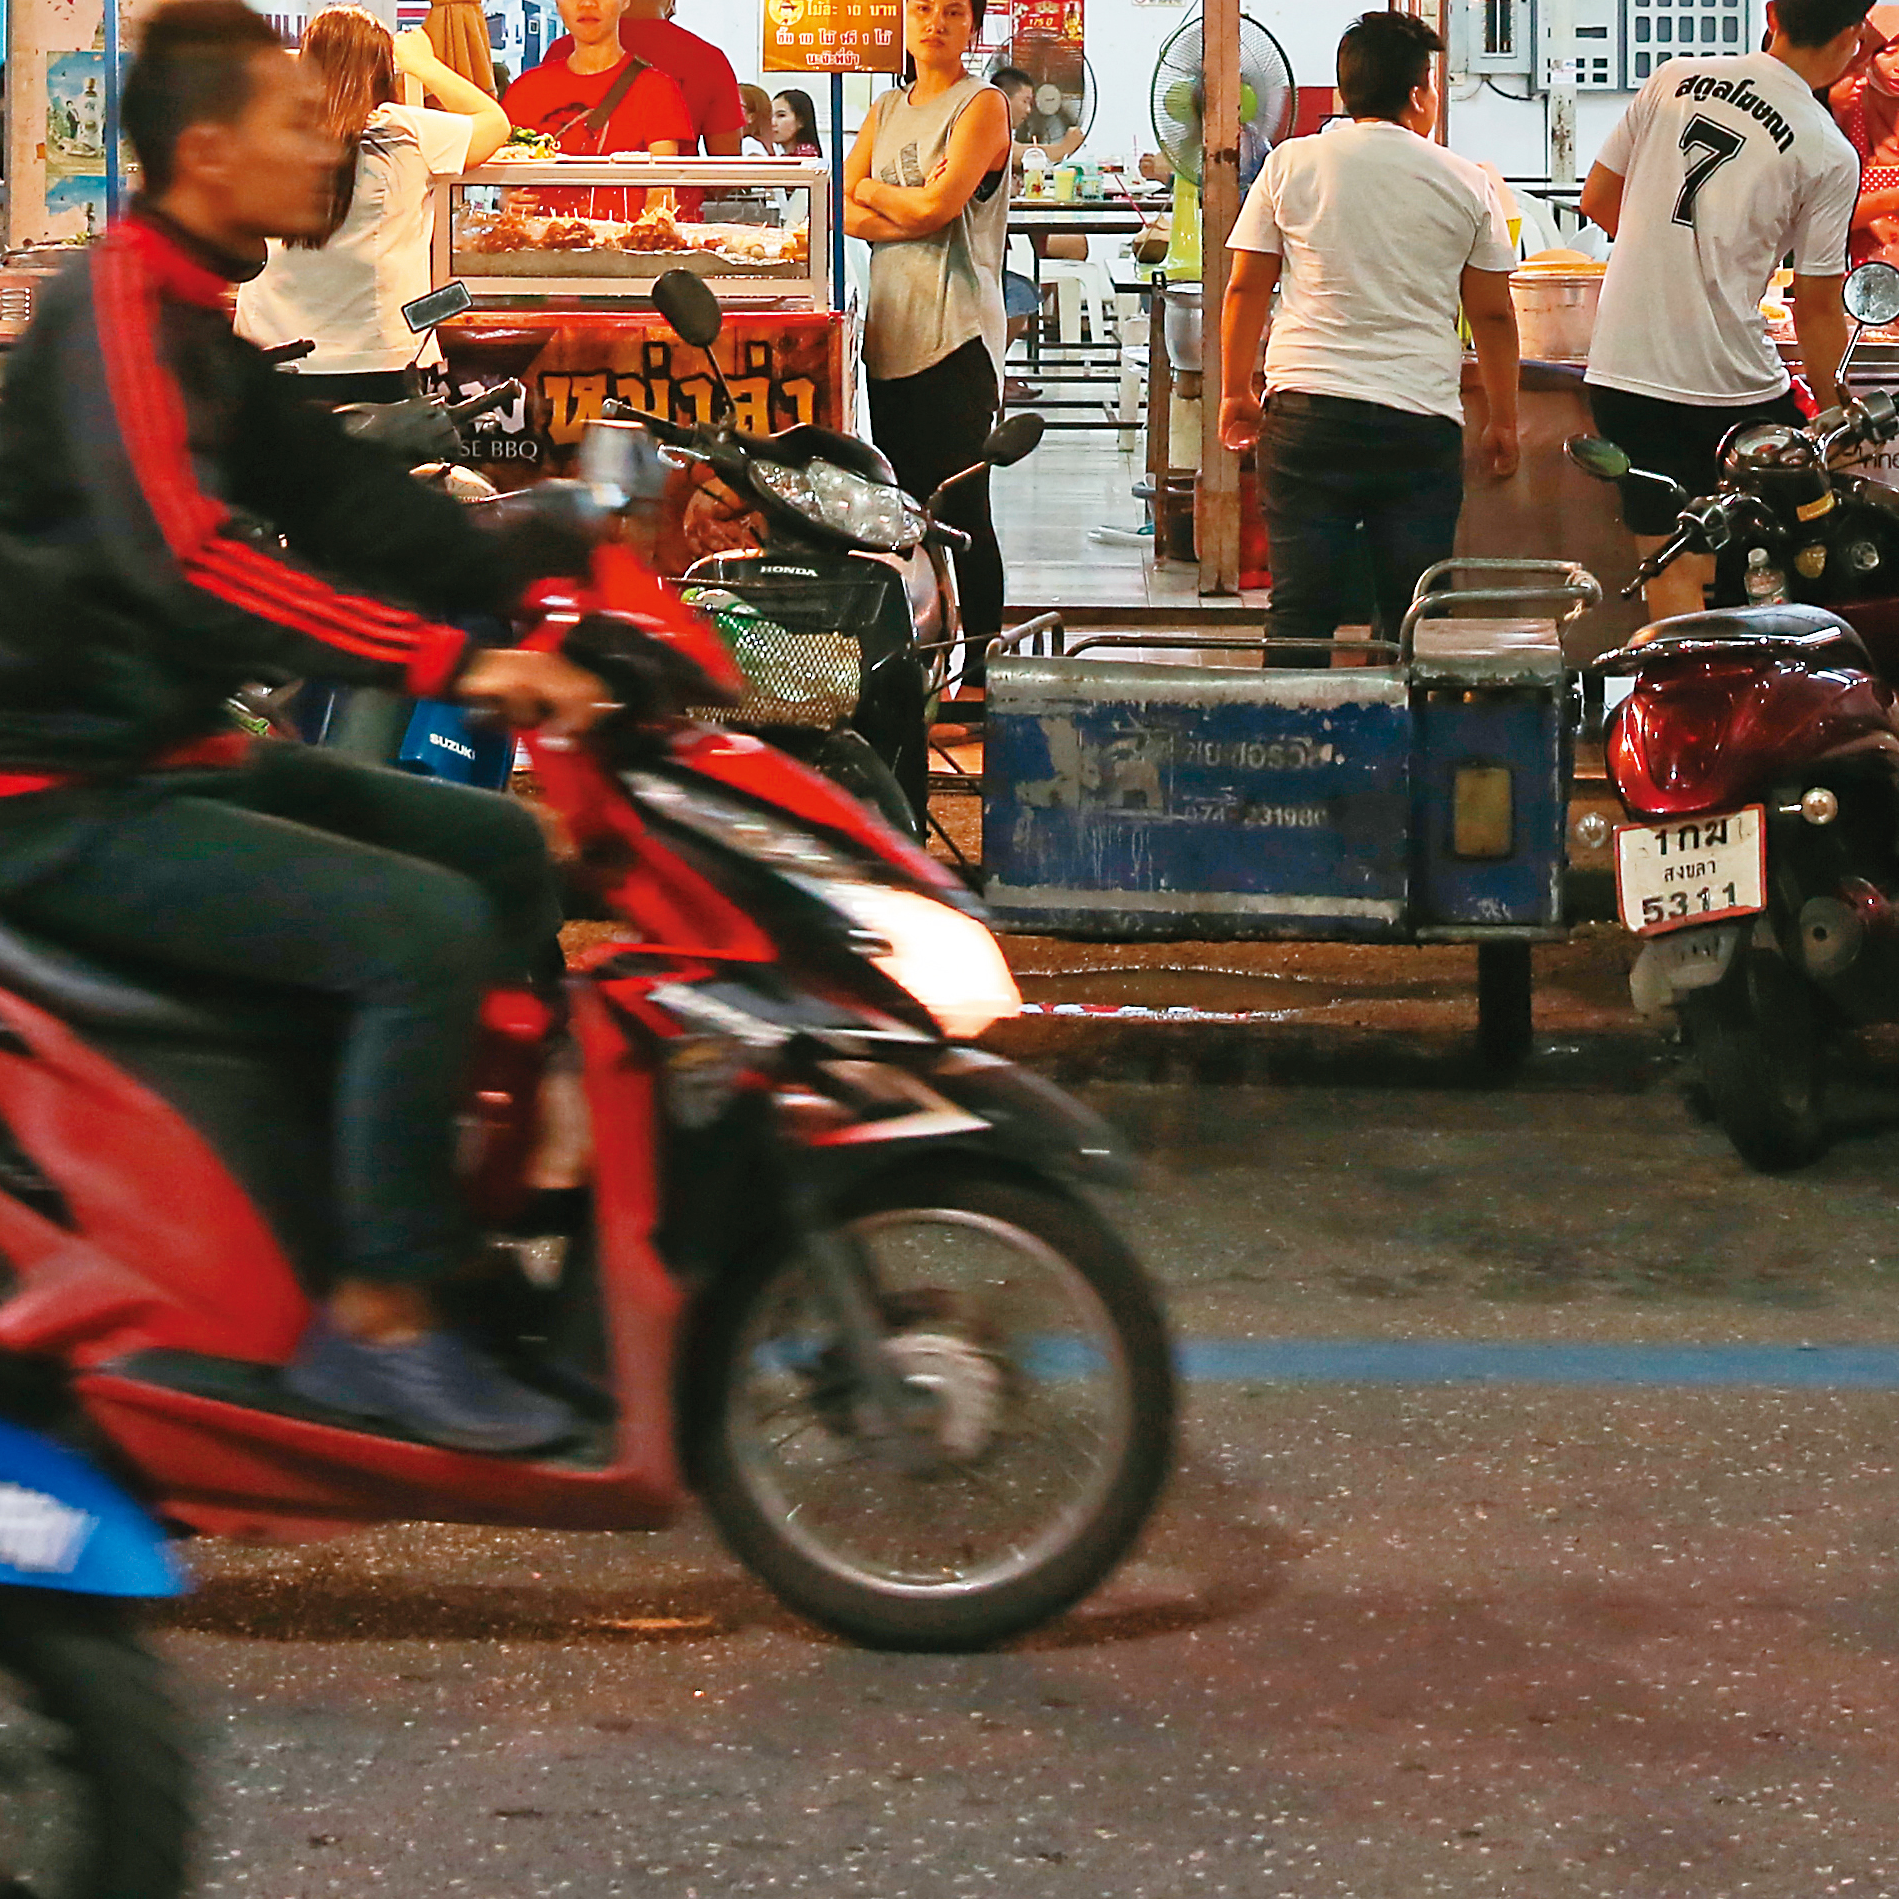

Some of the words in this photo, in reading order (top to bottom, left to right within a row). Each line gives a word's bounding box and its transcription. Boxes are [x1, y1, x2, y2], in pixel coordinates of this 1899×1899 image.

[847, 4, 861, 16] 10
[870, 4, 897, 17] บาท
[799, 32, 814, 45] 10
[818, 28, 836, 45] ไม้
[874, 28, 893, 45] ไม้
[1671, 112, 1747, 229] 7
[491, 440, 538, 462] BBQ
[760, 564, 819, 579] HONDA
[1664, 860, 1716, 882] สงขลา
[1642, 881, 1736, 924] 5311
